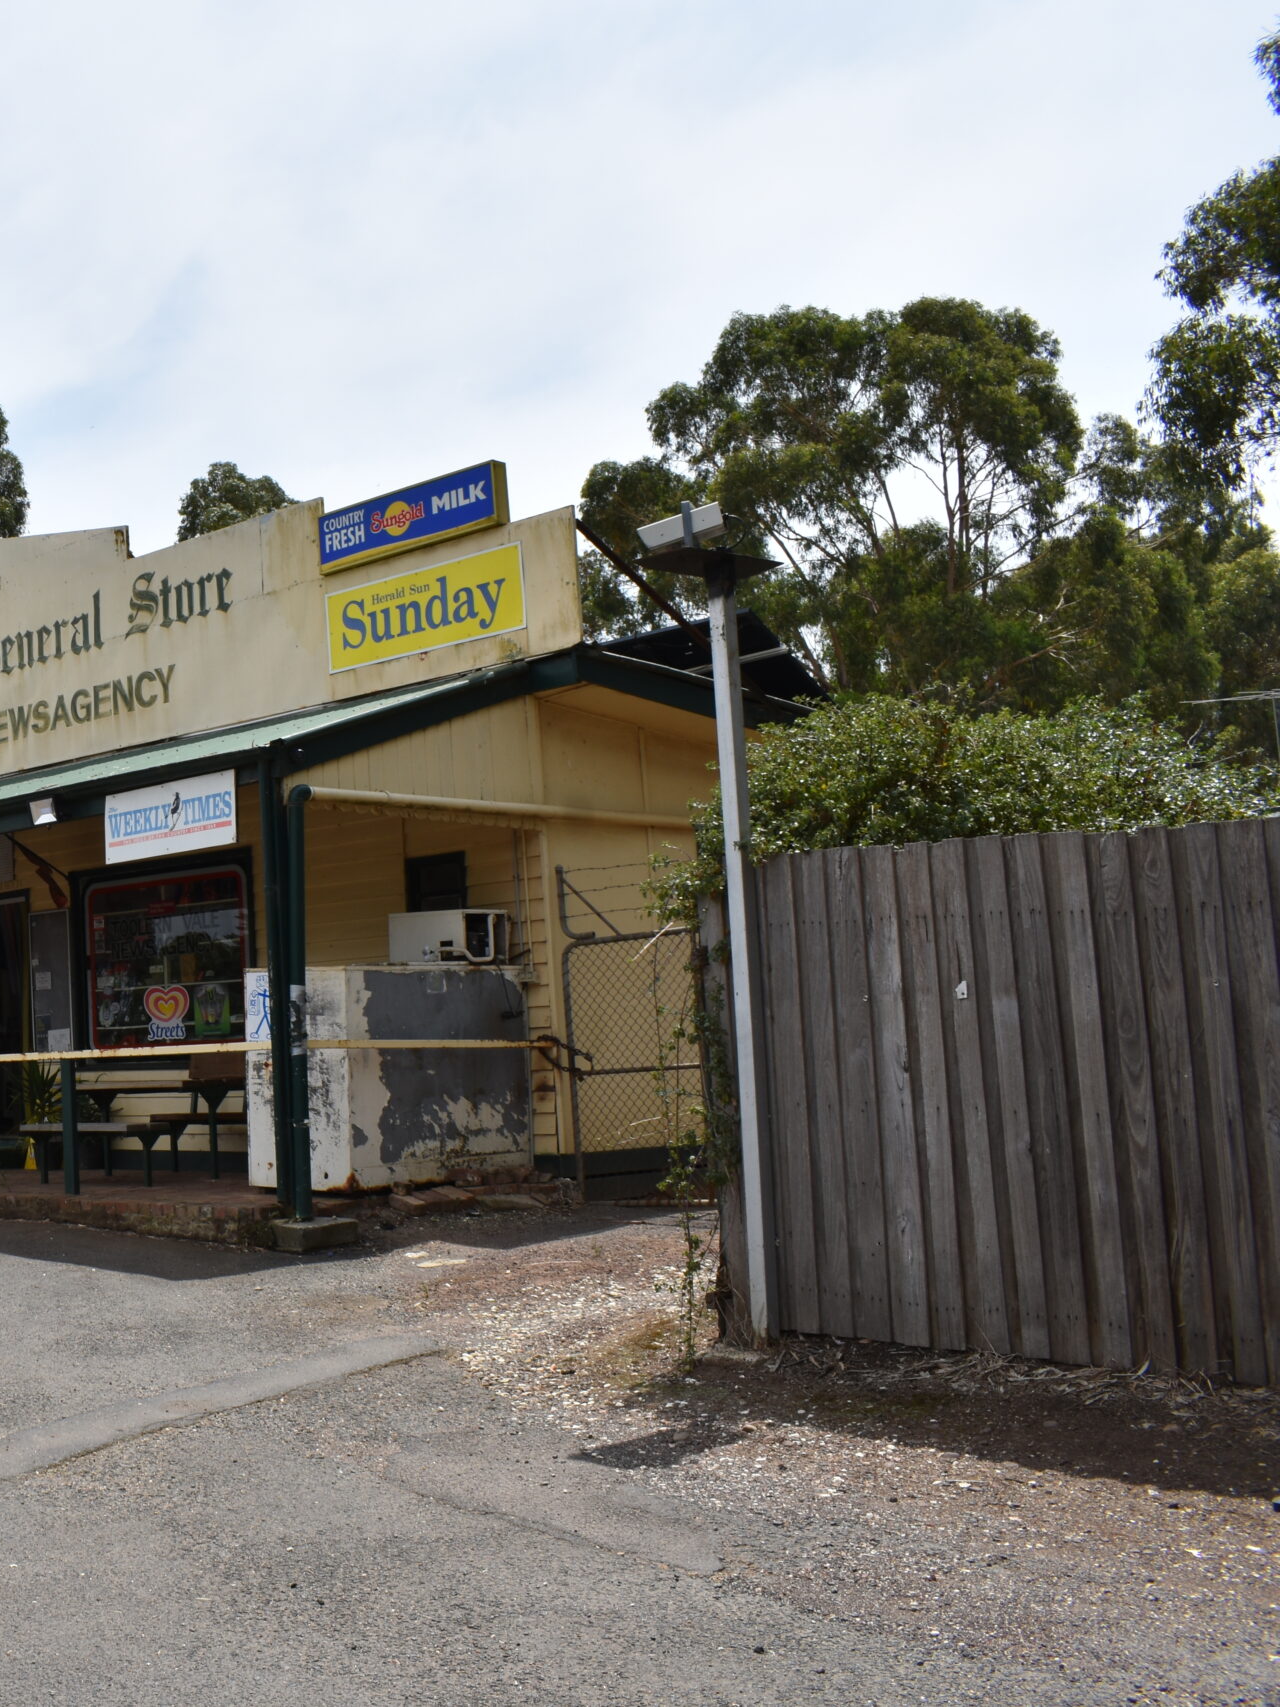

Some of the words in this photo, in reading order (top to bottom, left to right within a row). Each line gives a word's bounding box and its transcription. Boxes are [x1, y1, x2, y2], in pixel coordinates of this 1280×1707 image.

[431, 480, 487, 515] MILK
[324, 509, 365, 533] COUNTRY
[370, 501, 424, 533] Sungold
[325, 524, 366, 553] FRESH
[125, 567, 234, 640] Store
[371, 587, 406, 605] Herald
[409, 583, 430, 597] Sun
[342, 576, 506, 650] Sunday
[108, 803, 172, 839] WEEKLY
[181, 791, 233, 826] TIMES
[148, 1022, 186, 1039] Streets
